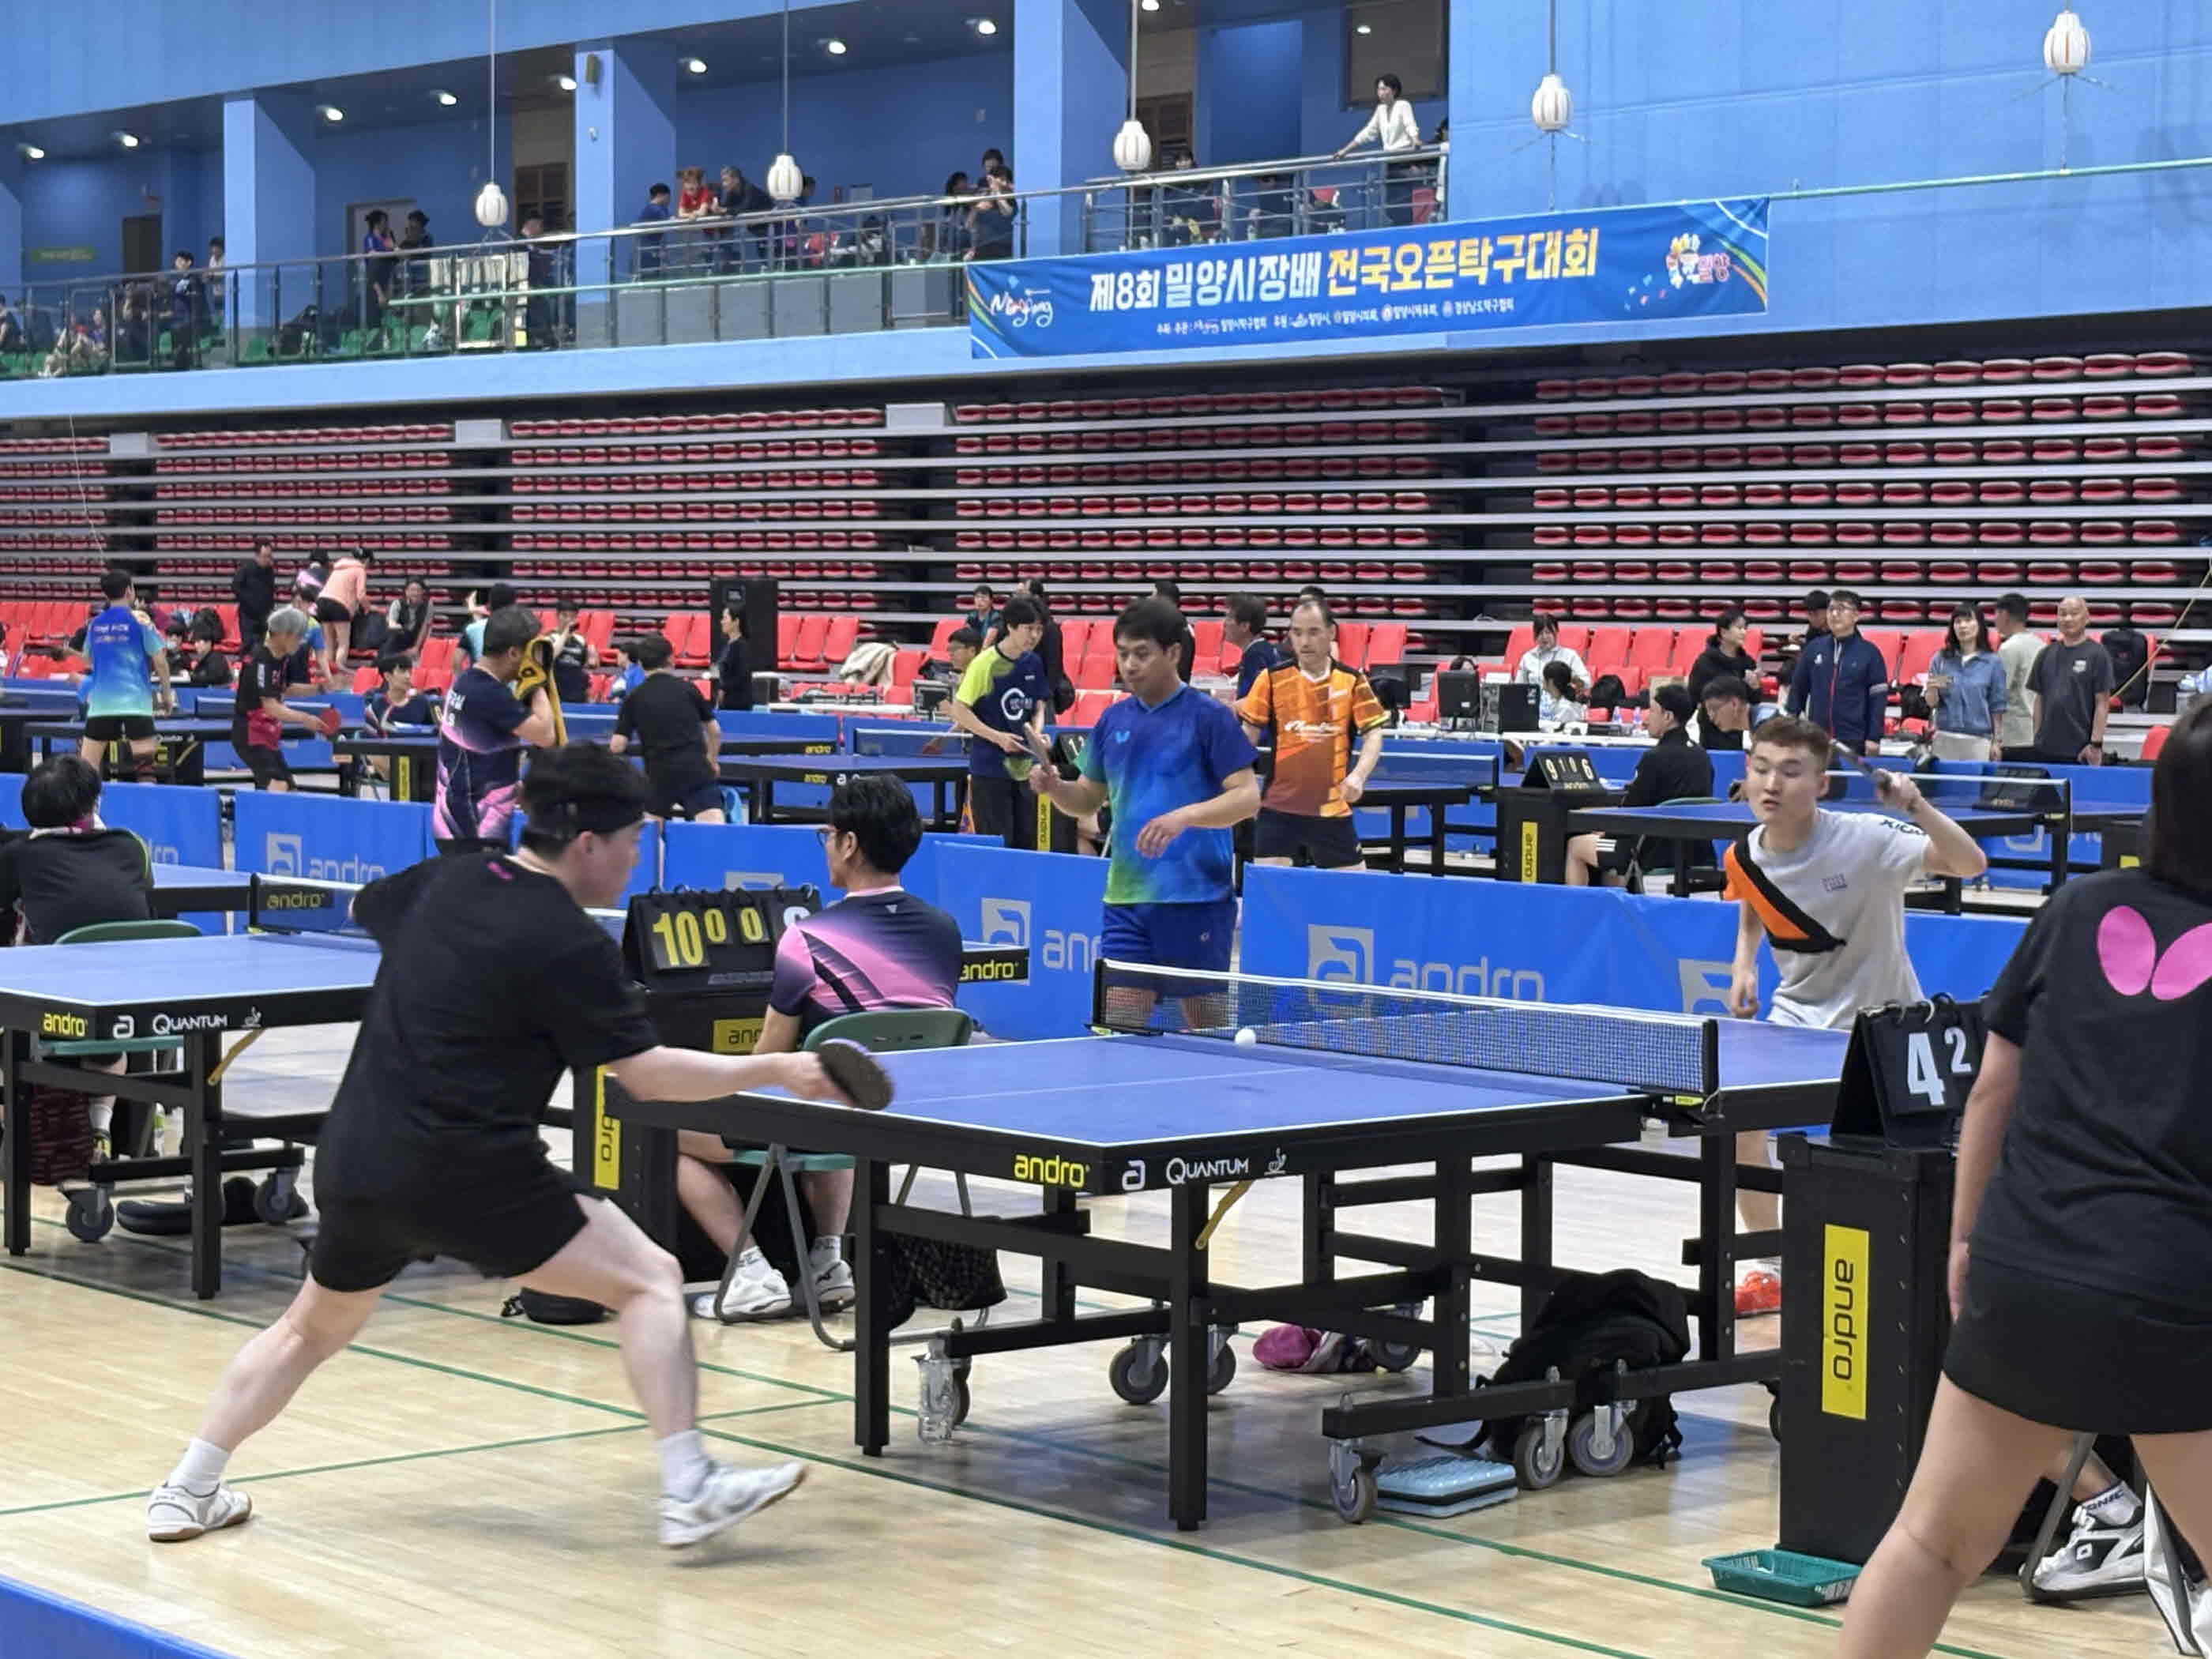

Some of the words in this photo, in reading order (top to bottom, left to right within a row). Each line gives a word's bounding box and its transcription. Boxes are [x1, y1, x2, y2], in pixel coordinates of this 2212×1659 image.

[1089, 269, 1159, 312] 제8회
[1164, 251, 1322, 307] 밀양시장배
[1327, 228, 1598, 295] 전국오픈탁구대회
[1545, 758, 1558, 781] 9
[1582, 758, 1593, 781] 6
[267, 892, 321, 908] andro
[653, 912, 705, 966] 10
[705, 909, 727, 942] 0
[740, 907, 763, 941] 0
[960, 959, 1014, 980] andro
[43, 1011, 85, 1037] andro
[152, 1013, 228, 1035] QUANTUM
[1908, 1033, 1945, 1106] 4
[1944, 1027, 1973, 1074] 2
[1014, 1154, 1085, 1187] andro
[1166, 1157, 1248, 1185] QUANTUM
[1834, 1258, 1857, 1380] andro
